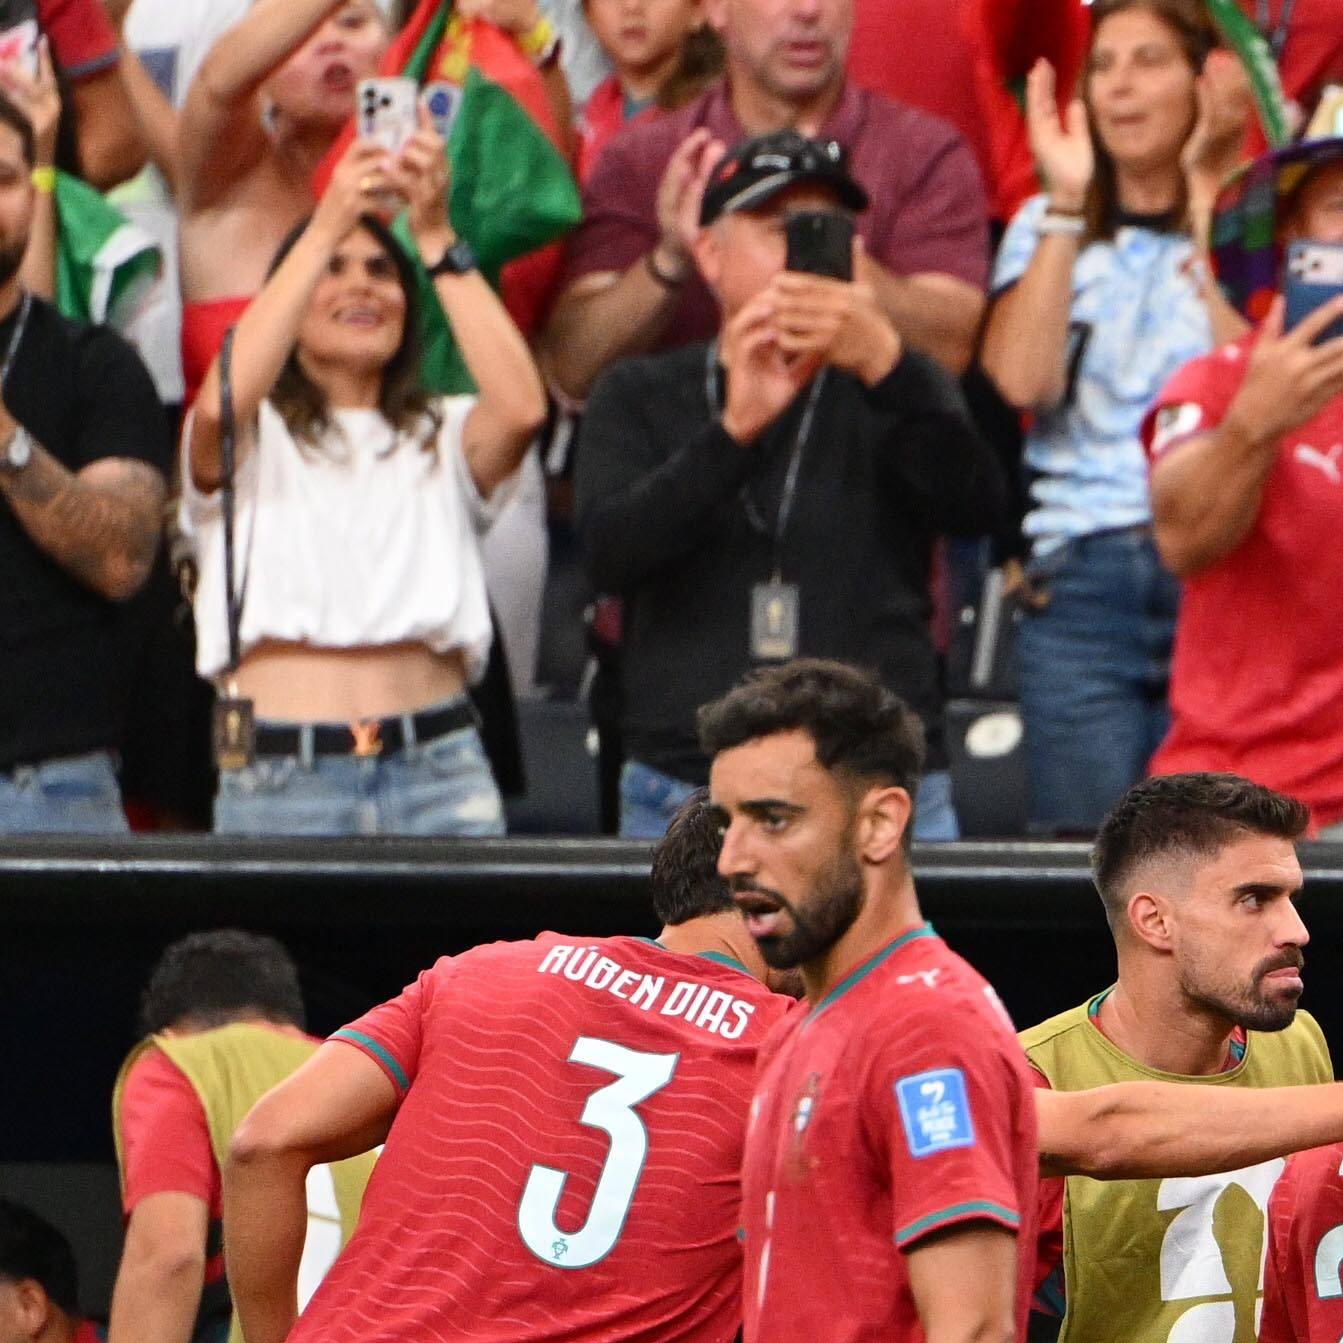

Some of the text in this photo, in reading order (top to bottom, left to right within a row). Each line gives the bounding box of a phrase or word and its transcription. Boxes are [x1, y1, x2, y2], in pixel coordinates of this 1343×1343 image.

[537, 944, 756, 1039] RÚBEN DIAS
[518, 1035, 681, 1269] 3
